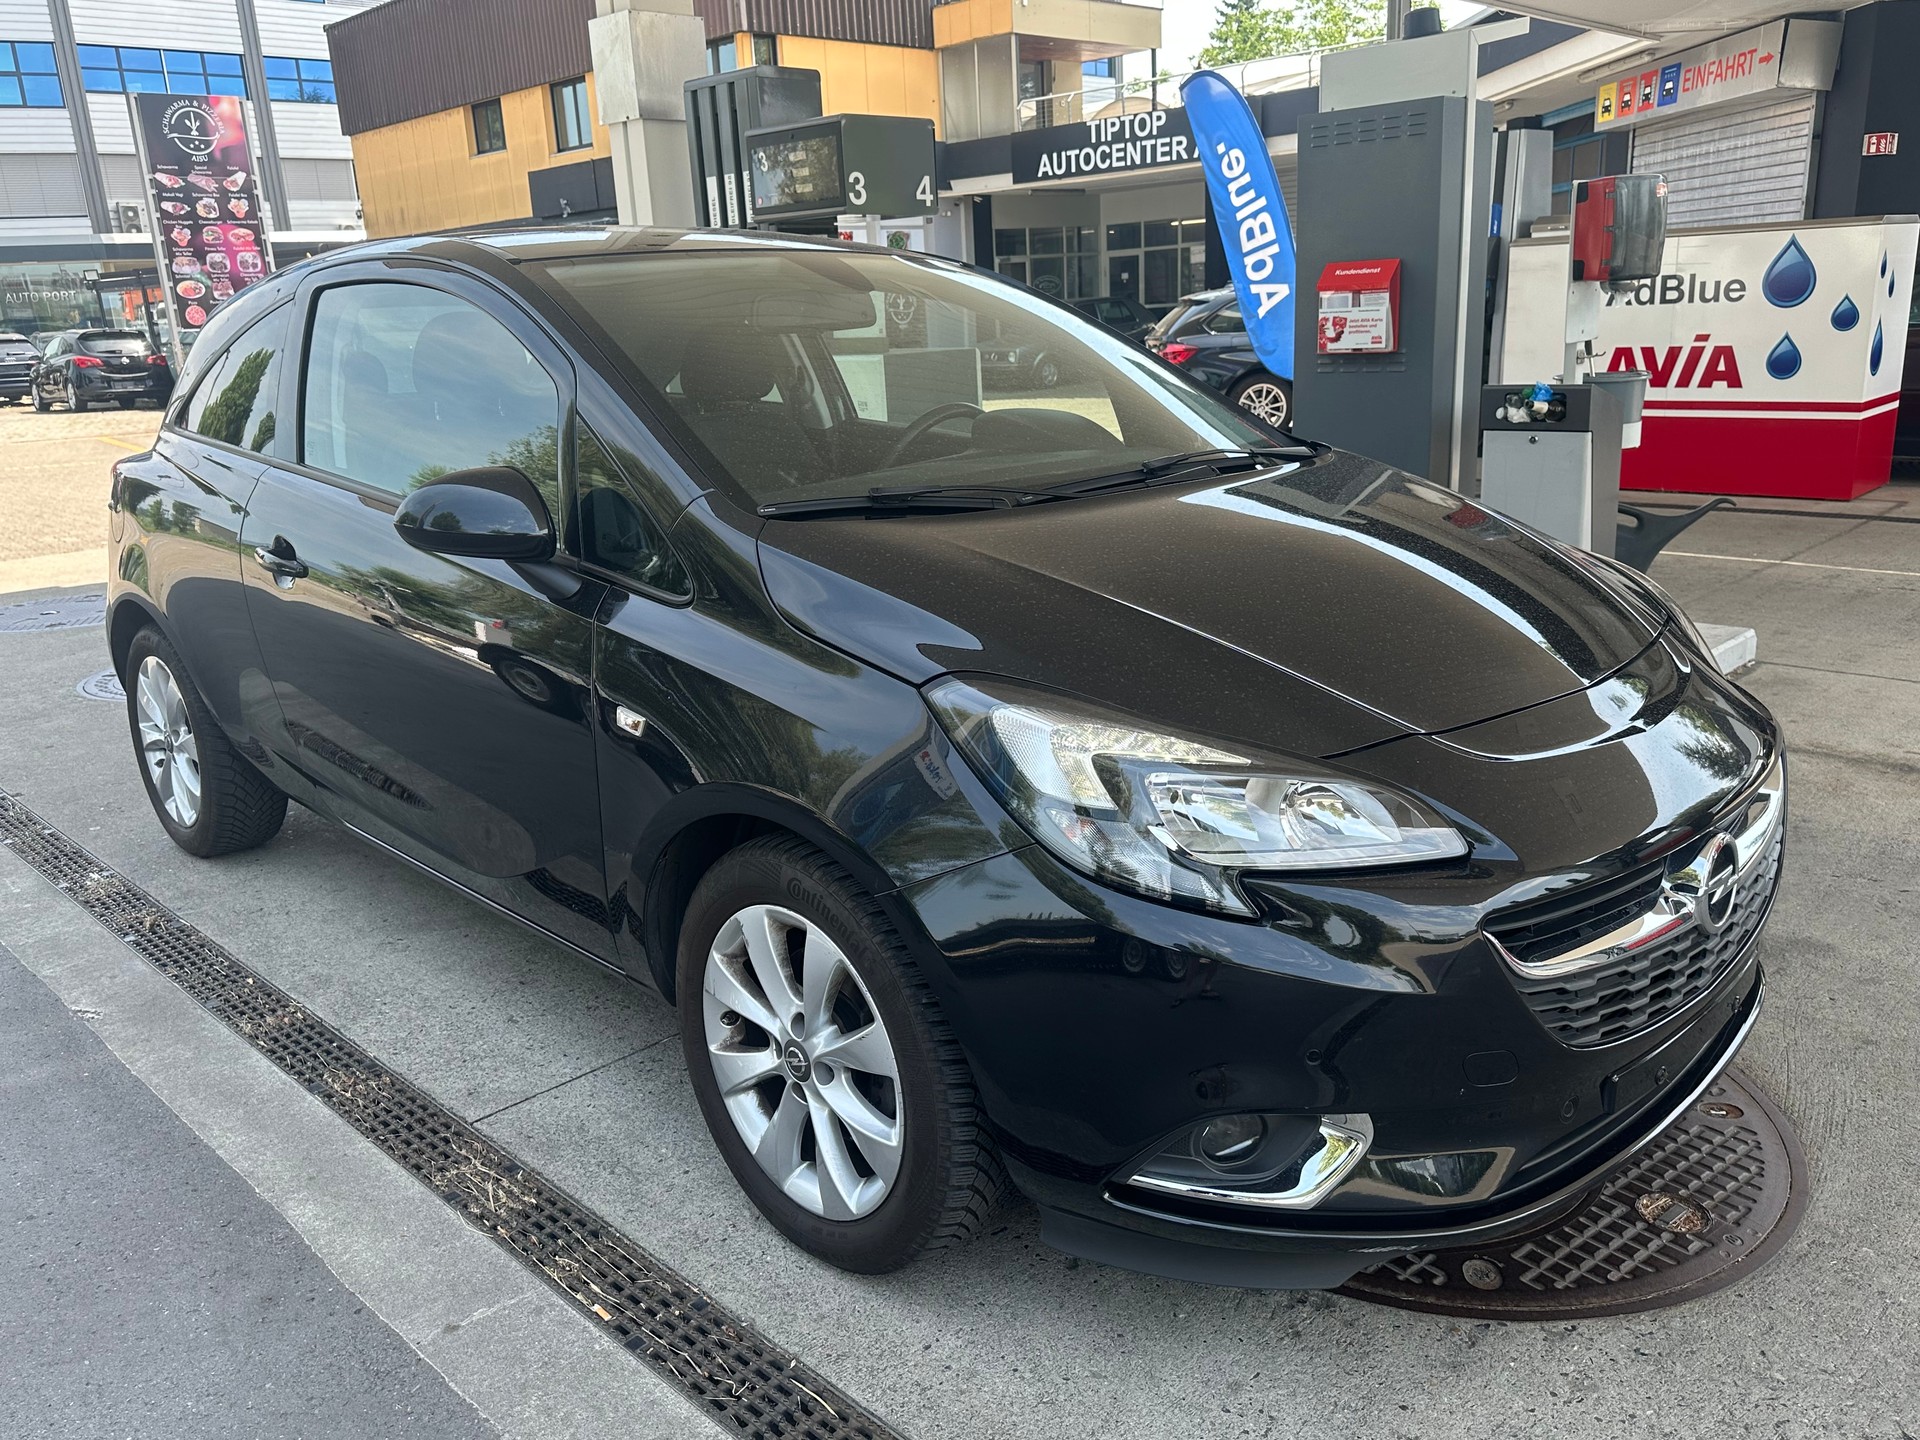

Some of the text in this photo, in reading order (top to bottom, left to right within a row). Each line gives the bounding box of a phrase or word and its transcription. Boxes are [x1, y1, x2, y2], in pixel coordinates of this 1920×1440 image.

[1682, 48, 1757, 93] EINFAHRT
[1086, 110, 1166, 143] TIPTOP
[758, 151, 769, 172] 3
[1037, 135, 1188, 177] AUTOCENTER
[848, 171, 867, 205] 3
[916, 175, 934, 206] 4
[1335, 267, 1381, 275] Kundendienst
[5, 290, 76, 304] AUTO PORT
